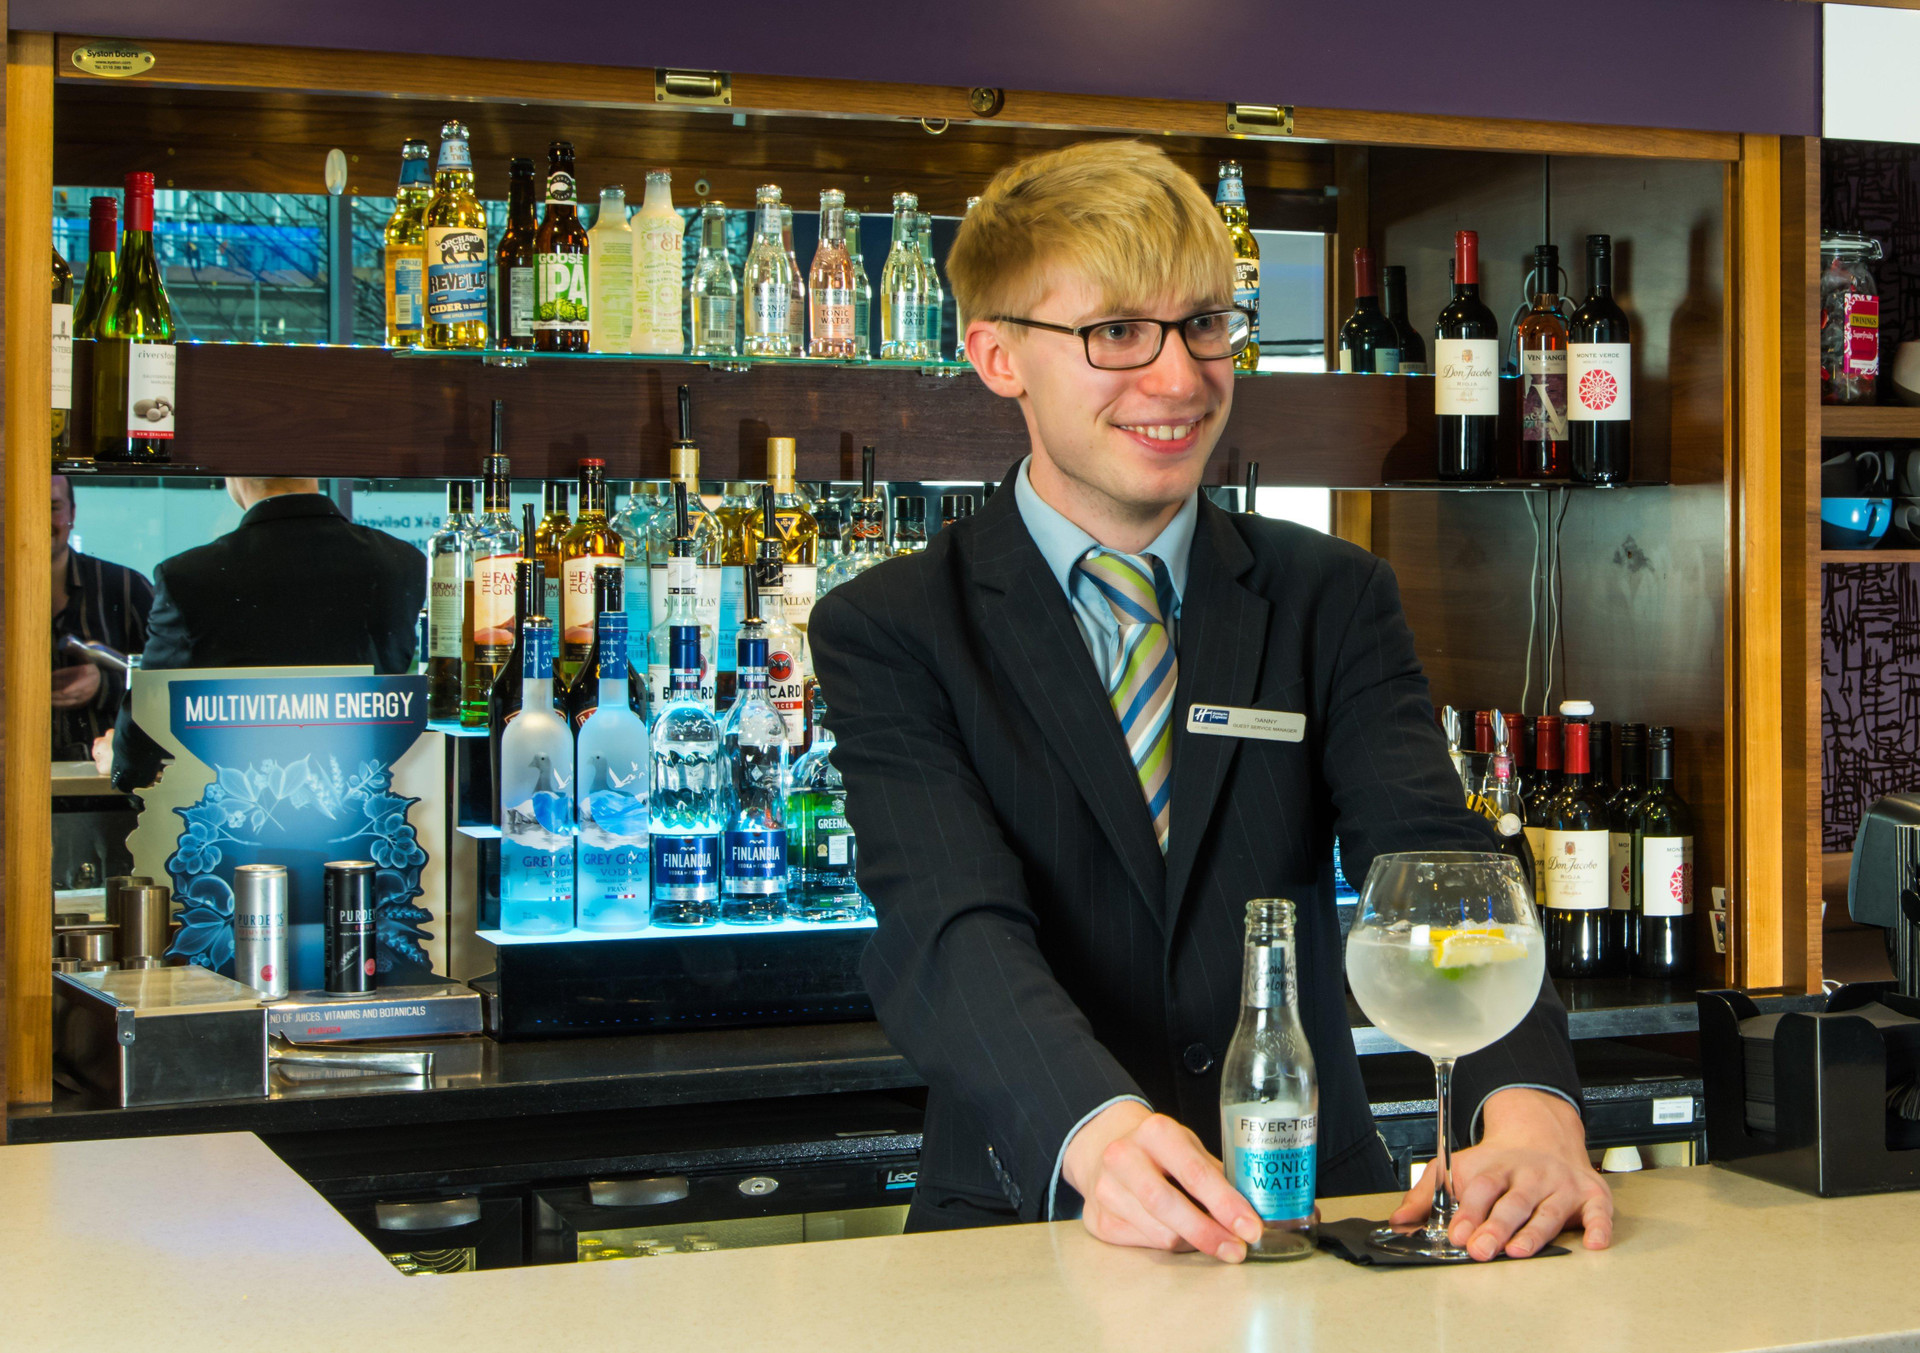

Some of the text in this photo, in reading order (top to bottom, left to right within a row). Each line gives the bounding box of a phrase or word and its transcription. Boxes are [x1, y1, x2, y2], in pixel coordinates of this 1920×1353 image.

[87, 49, 114, 58] Syston
[439, 234, 480, 252] ORCHARD
[453, 242, 471, 254] PIG
[538, 253, 585, 264] GOOSE
[1237, 264, 1255, 273] HARD
[430, 270, 487, 296] REVELLE
[538, 263, 588, 307] IPA
[429, 302, 463, 314] CIDER
[758, 303, 786, 312] TONIC
[821, 309, 849, 317] TONIC
[757, 311, 787, 319] WATER
[820, 317, 850, 325] WATER
[1851, 315, 1877, 326] TWININGS
[1852, 329, 1875, 341] Superfruity
[138, 349, 176, 359] riverston
[1442, 363, 1493, 380] Don Jacobo
[482, 571, 491, 596] THE
[569, 570, 578, 594] THE
[744, 674, 767, 683] FINLANDIA
[185, 691, 414, 722] MULTIVITAMIN ENERGY
[1254, 717, 1278, 725] DANNY
[817, 817, 852, 830] GREENA
[583, 853, 612, 866] GREY
[732, 845, 781, 861] FINLANDIA
[522, 854, 556, 868] GREY
[663, 853, 712, 868] FINLANDIA
[1548, 855, 1598, 872] Don Jacobo
[283, 1013, 293, 1024] OF
[324, 1009, 361, 1021] VITAMINS
[362, 1008, 378, 1019] AND
[379, 1006, 426, 1018] BOTANICALS
[1240, 1116, 1317, 1133] FEVER-TREE
[1246, 1133, 1298, 1149] Refreshingly
[1255, 1158, 1309, 1175] TONIC
[887, 1170, 919, 1184] Lec
[1253, 1174, 1310, 1190] WATER
